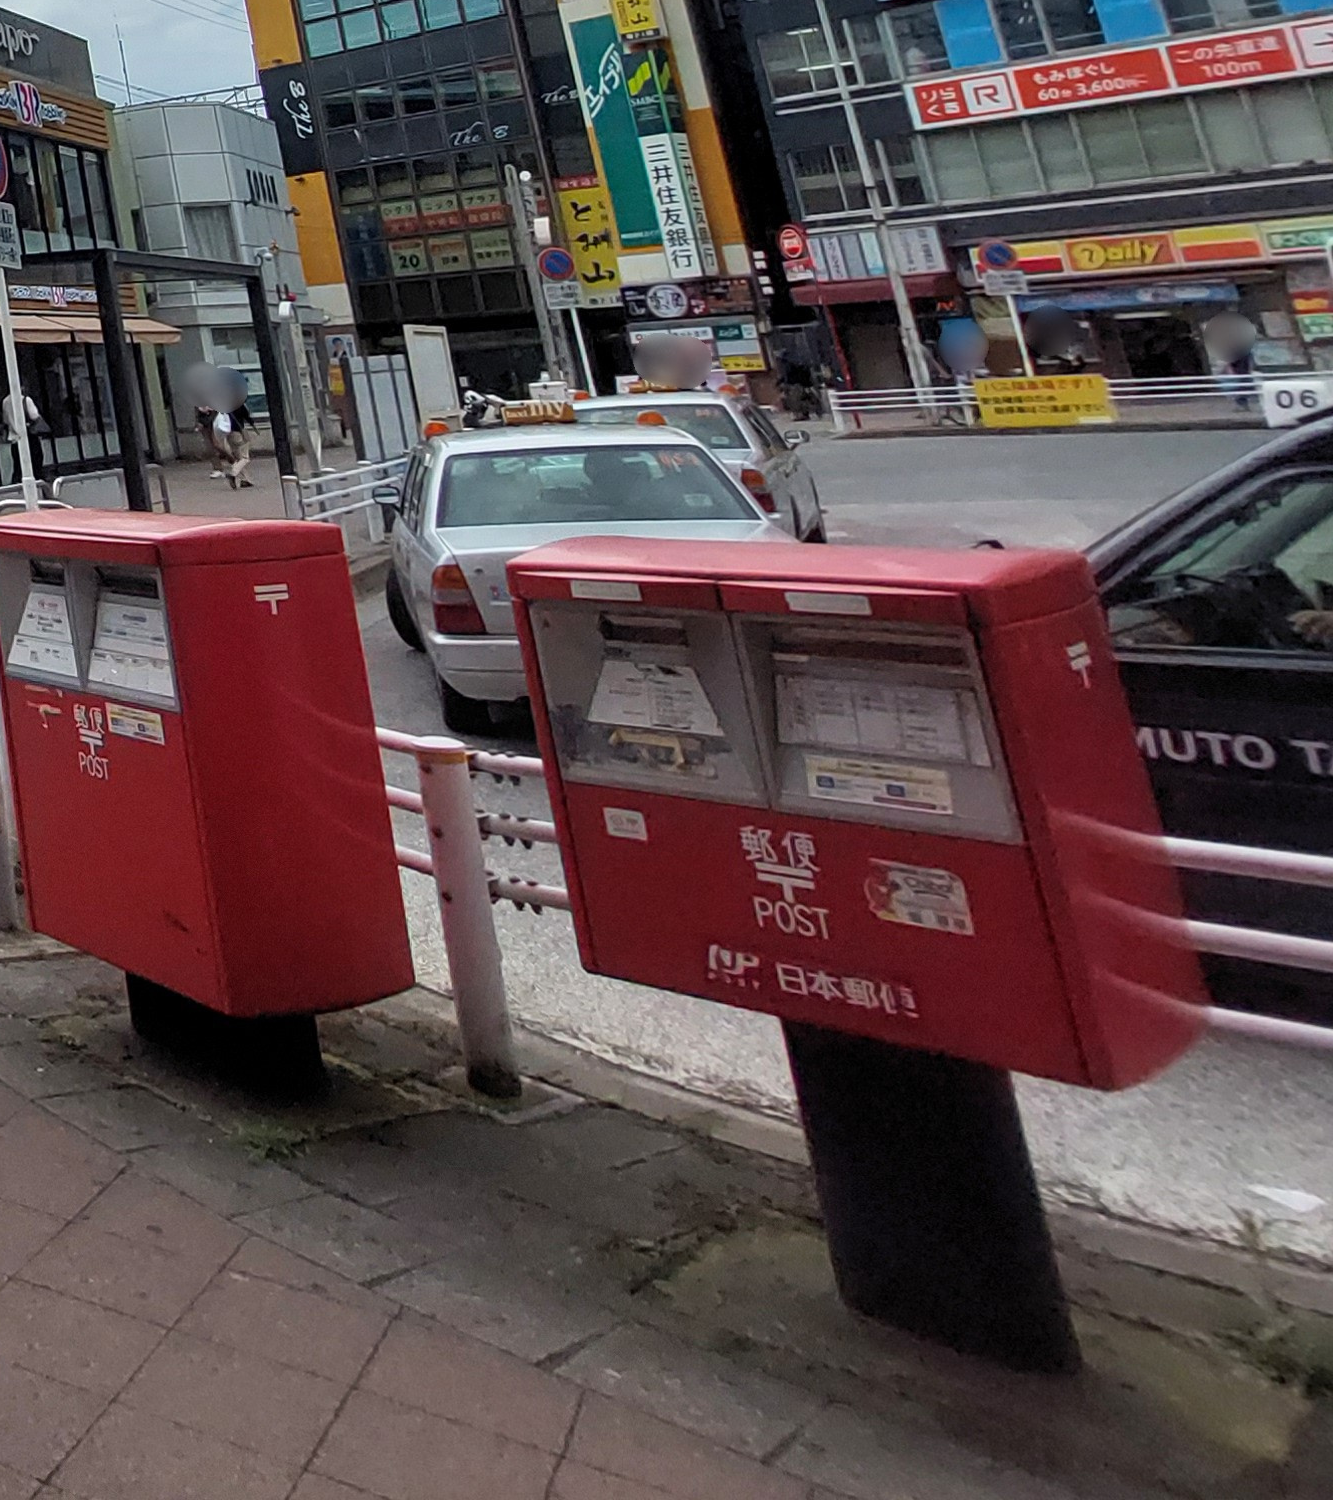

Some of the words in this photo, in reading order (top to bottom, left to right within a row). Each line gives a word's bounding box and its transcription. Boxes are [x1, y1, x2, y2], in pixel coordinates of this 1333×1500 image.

[1174, 36, 1282, 64] この先直進
[584, 46, 621, 114] エイブル
[1033, 61, 1115, 86] もみほぐし
[1200, 58, 1262, 79] 100m
[289, 79, 307, 98] B
[972, 83, 1002, 107] R
[284, 99, 314, 139] The
[449, 122, 484, 147] The
[493, 125, 510, 139] B
[645, 143, 693, 269] 三井住友銀行
[677, 141, 716, 268] 三井住友銀行
[398, 254, 421, 269] 20
[1275, 390, 1319, 409] 06
[73, 703, 105, 735] 郵便
[78, 751, 109, 781] POST
[1289, 738, 1333, 777] T
[739, 825, 822, 873] 郵便
[752, 895, 830, 941] POST
